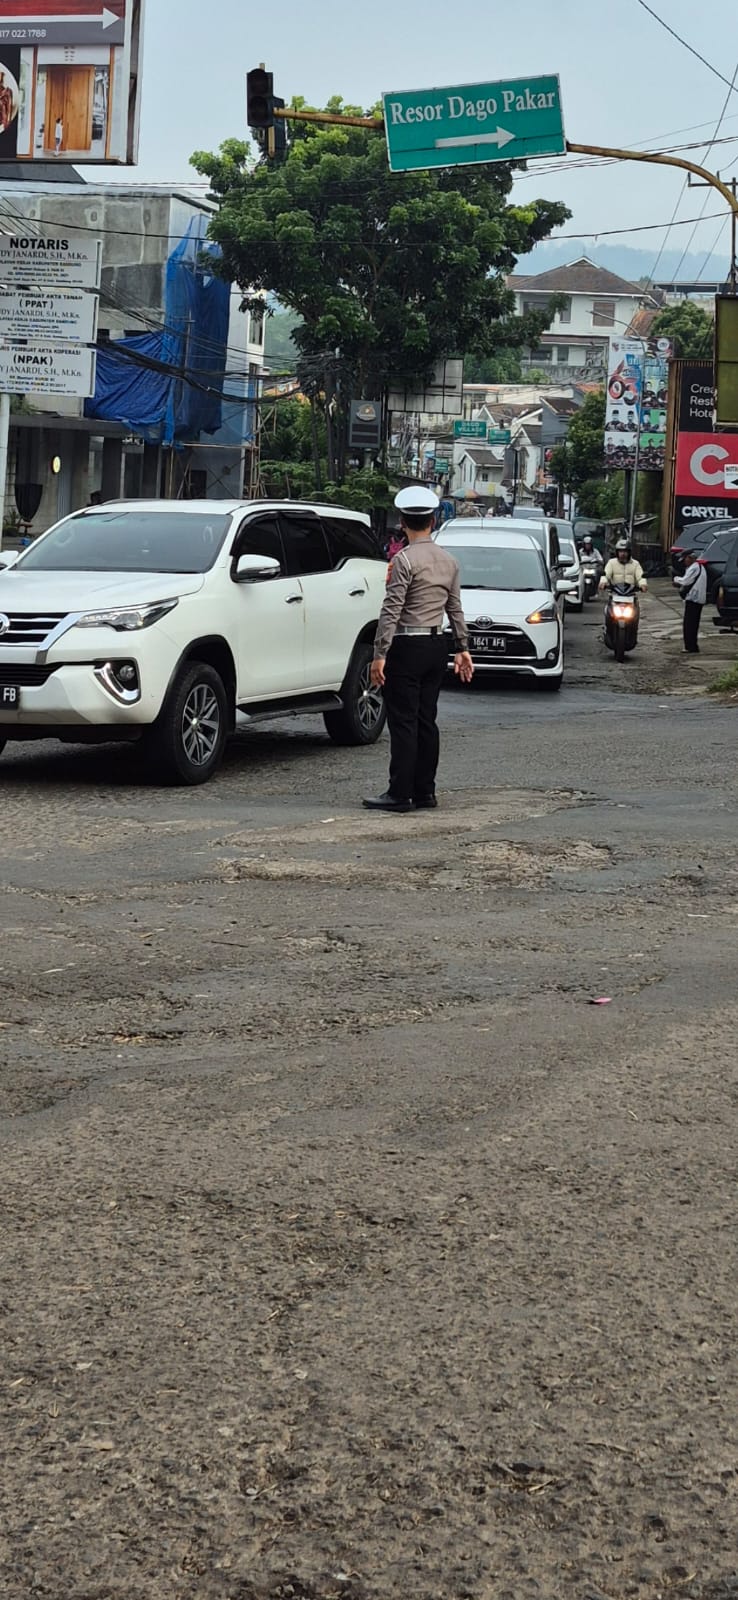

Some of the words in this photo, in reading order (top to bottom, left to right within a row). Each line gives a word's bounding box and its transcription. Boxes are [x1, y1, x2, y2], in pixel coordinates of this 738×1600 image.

[12, 29, 26, 38] 022
[27, 29, 46, 38] 1788
[389, 102, 444, 125] Resor
[447, 95, 498, 121] Dago
[501, 88, 556, 113] Pakar
[10, 238, 69, 251] NOTARIS
[0, 249, 10, 257] DY
[690, 443, 730, 486] C
[681, 505, 734, 519] CARTEL
[3, 687, 16, 702] FB
